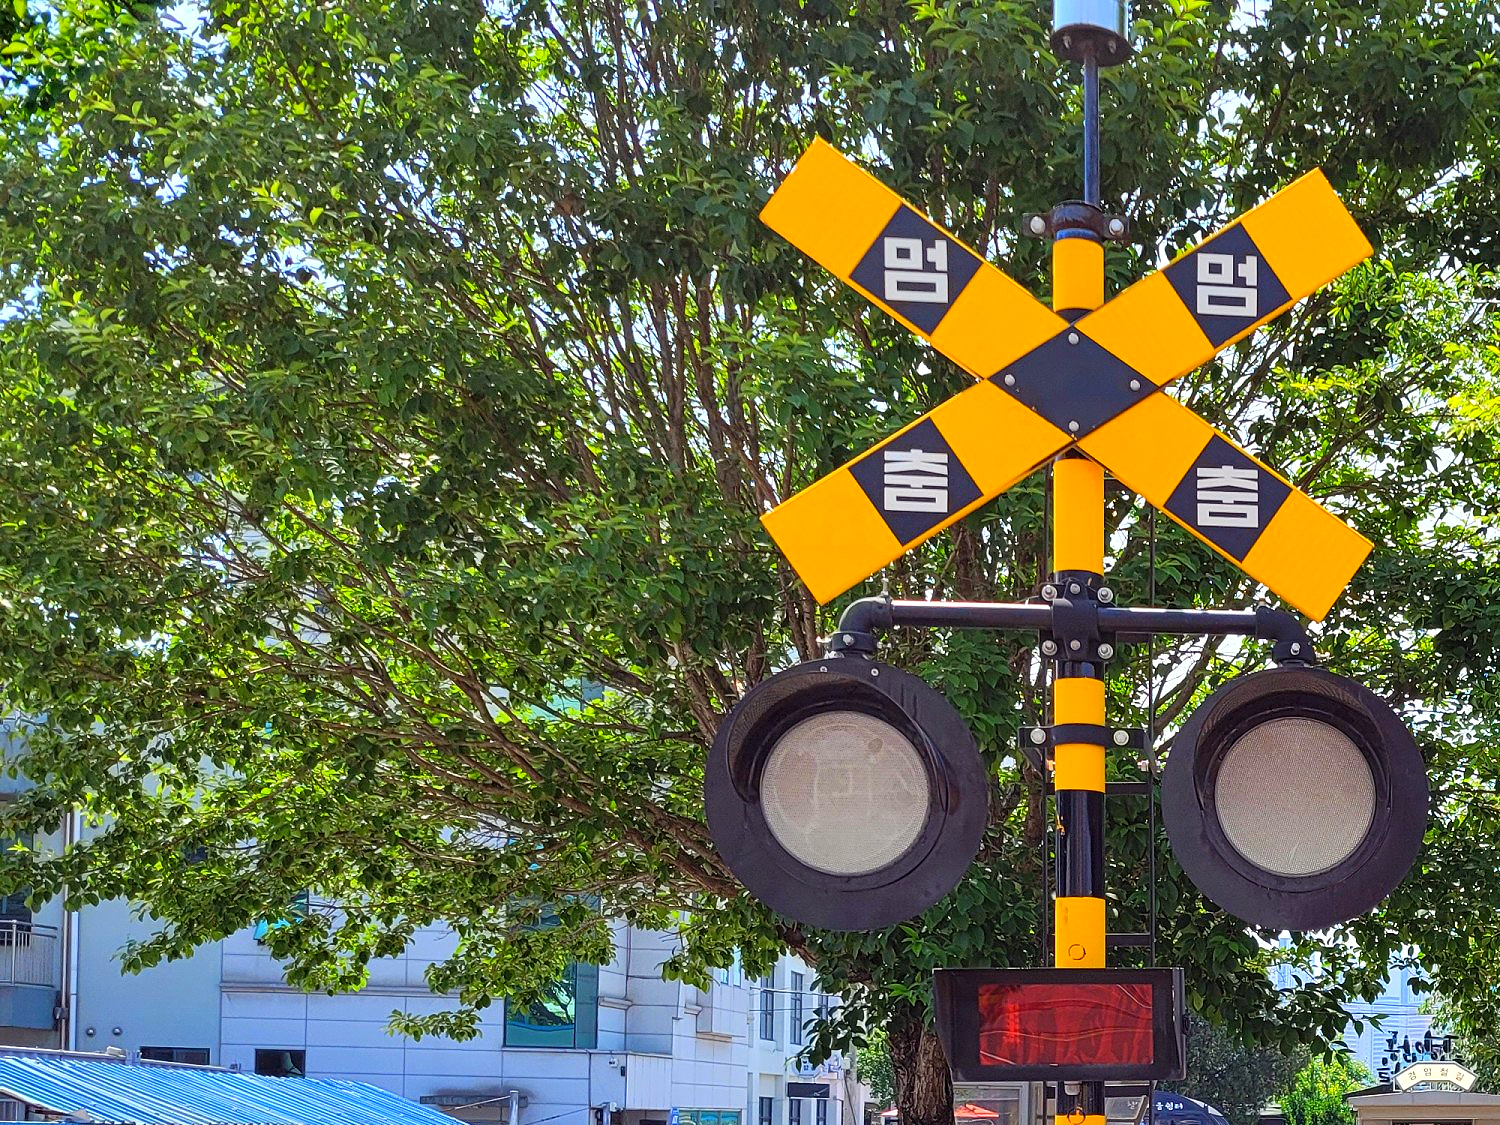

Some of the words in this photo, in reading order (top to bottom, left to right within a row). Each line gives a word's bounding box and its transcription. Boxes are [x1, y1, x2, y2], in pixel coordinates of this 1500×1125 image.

[884, 237, 948, 303] 멈
[1197, 252, 1257, 317] 멈
[884, 449, 948, 512] 춤
[1196, 465, 1258, 527] 춤
